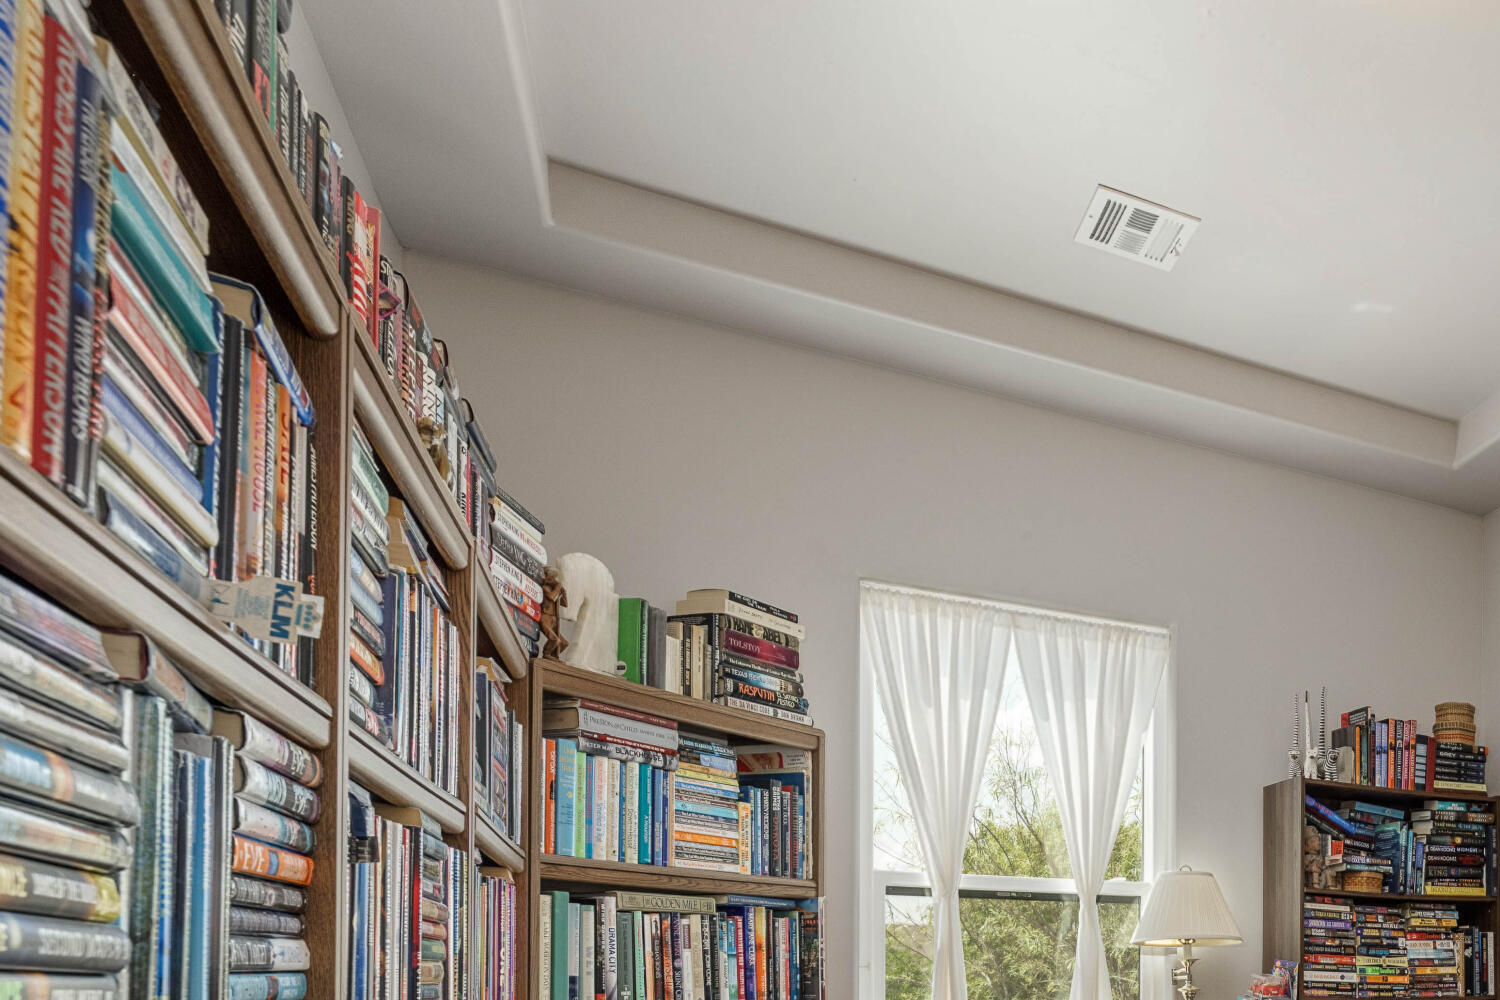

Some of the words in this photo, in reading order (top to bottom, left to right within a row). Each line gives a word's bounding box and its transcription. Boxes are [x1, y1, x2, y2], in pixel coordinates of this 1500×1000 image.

[270, 584, 295, 639] KLM
[729, 638, 761, 653] TOLSTOY
[738, 683, 775, 701] RASPUTIN
[608, 928, 616, 955] DRAMA
[608, 956, 616, 974] CITY
